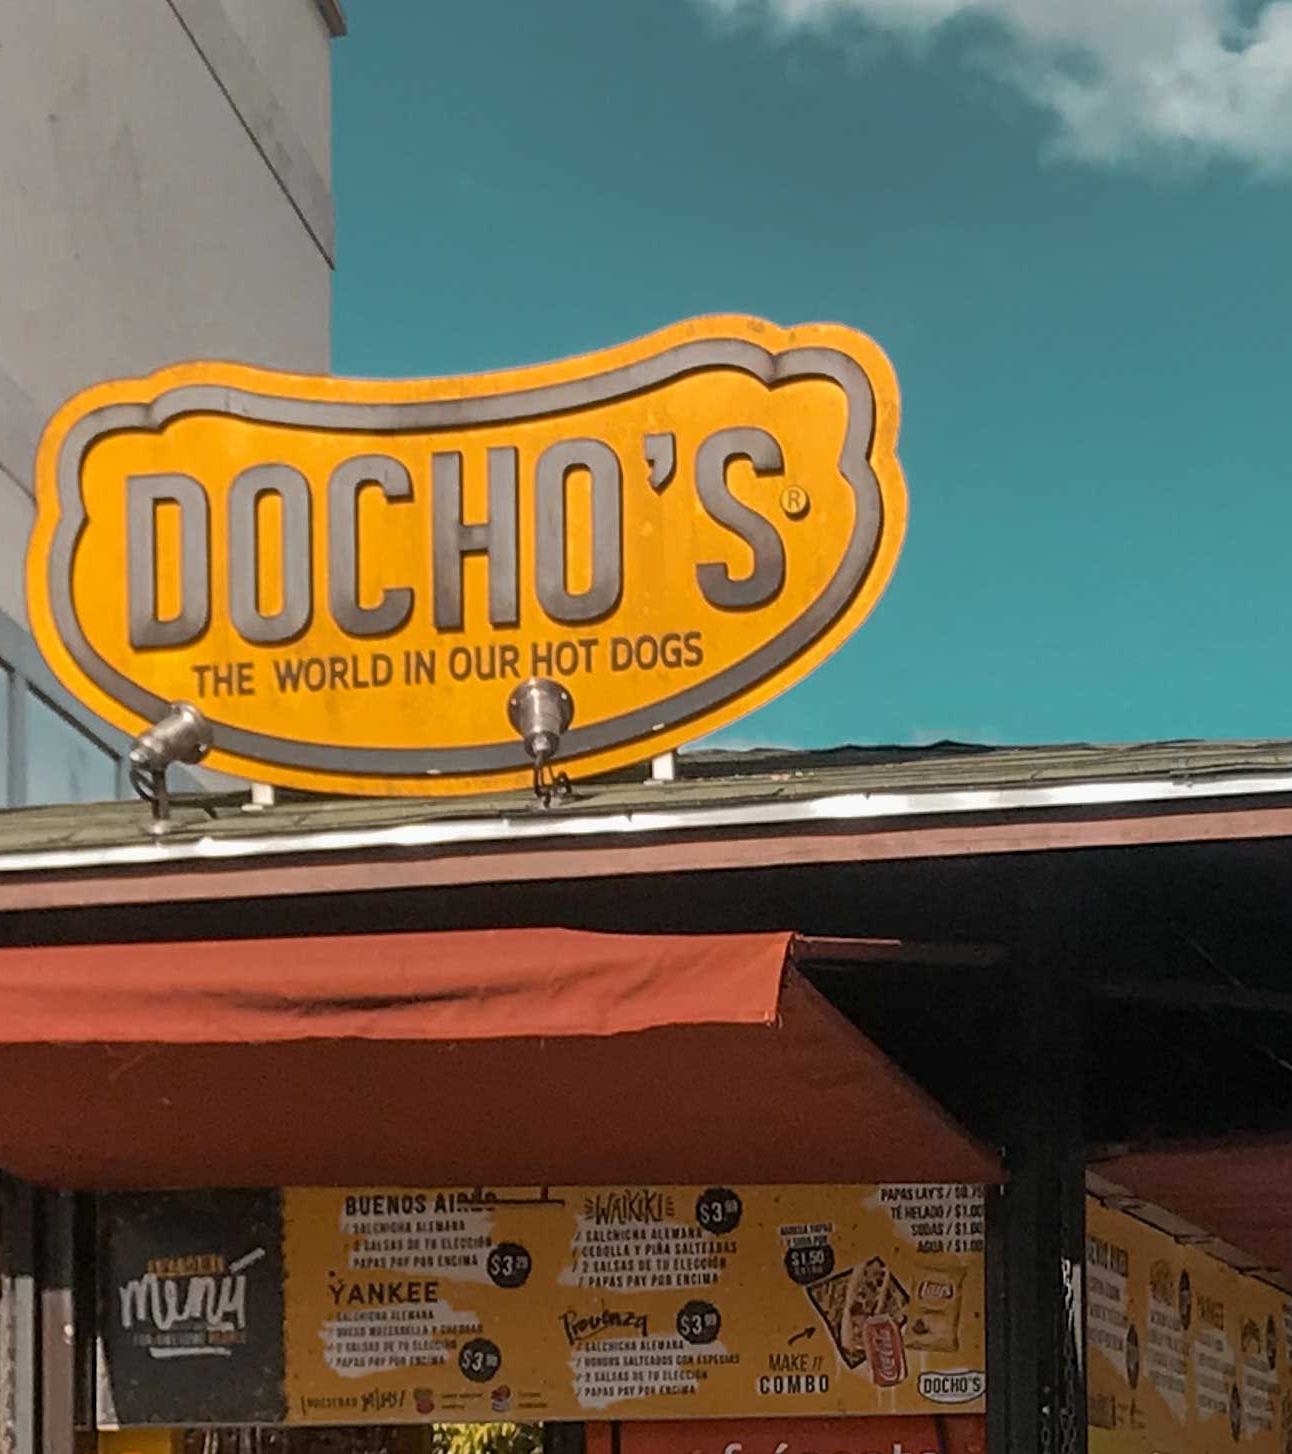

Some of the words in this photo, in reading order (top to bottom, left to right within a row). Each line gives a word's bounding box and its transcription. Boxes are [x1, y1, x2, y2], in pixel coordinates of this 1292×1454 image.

[126, 426, 786, 650] DOCHO'S
[192, 664, 255, 697] THE
[273, 656, 394, 693] WORLD
[403, 651, 436, 685] IN
[448, 645, 520, 680] OUR
[531, 638, 603, 675] HOT
[610, 632, 704, 672] DOGS
[881, 1187, 913, 1201] PAPAS
[346, 1194, 426, 1216] BUENOS
[890, 1204, 902, 1219] TÉ
[911, 1222, 944, 1236] SODAS
[329, 1282, 439, 1305] YANKEE
[769, 1353, 807, 1371] MAKE
[760, 1374, 829, 1395] COMBO
[922, 1375, 981, 1393] DOCHO'S
